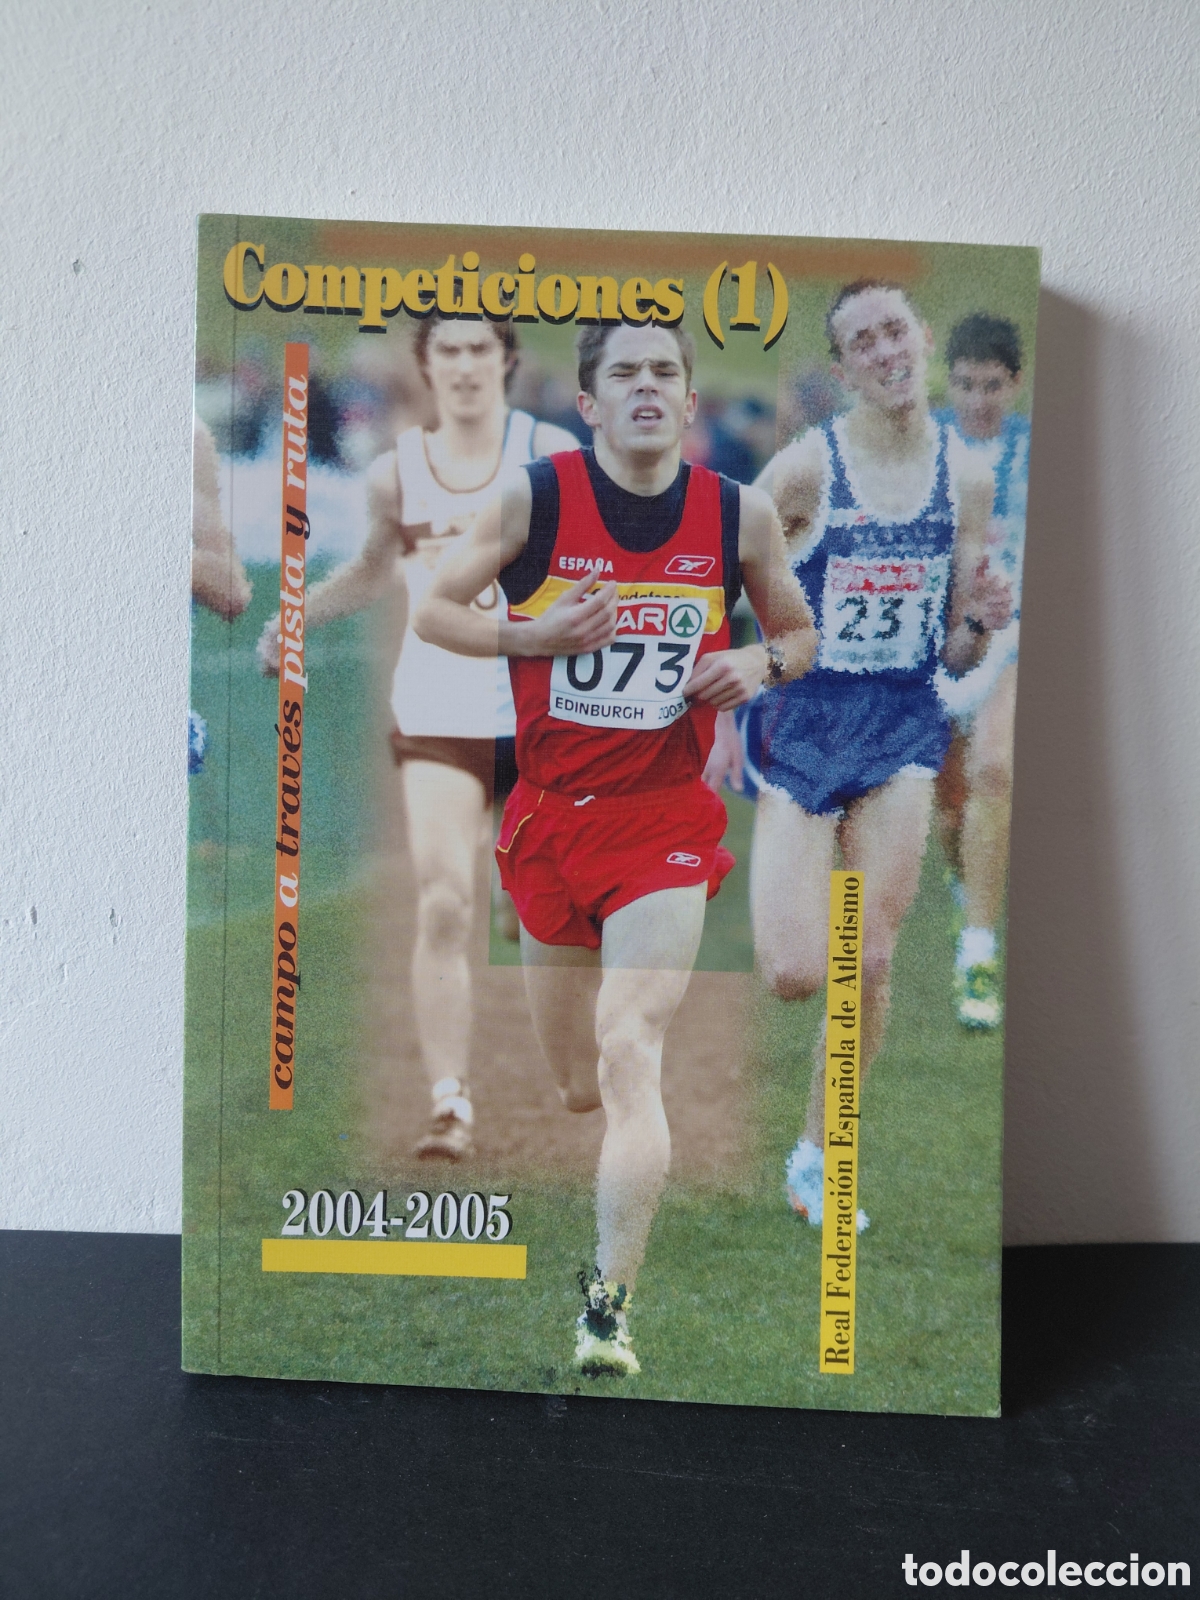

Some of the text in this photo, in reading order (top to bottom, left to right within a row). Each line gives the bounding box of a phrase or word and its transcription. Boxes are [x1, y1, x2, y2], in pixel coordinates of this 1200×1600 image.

[223, 241, 790, 351] Competiciones (1)
[558, 556, 613, 573] ESPAÑA
[566, 642, 690, 694] 073
[273, 374, 311, 1090] campo a través pista y ruta
[555, 697, 644, 720] EDINBURGH
[824, 877, 861, 1366] Real Federación Española de Atletismo
[281, 1188, 512, 1241] 2004-2005
